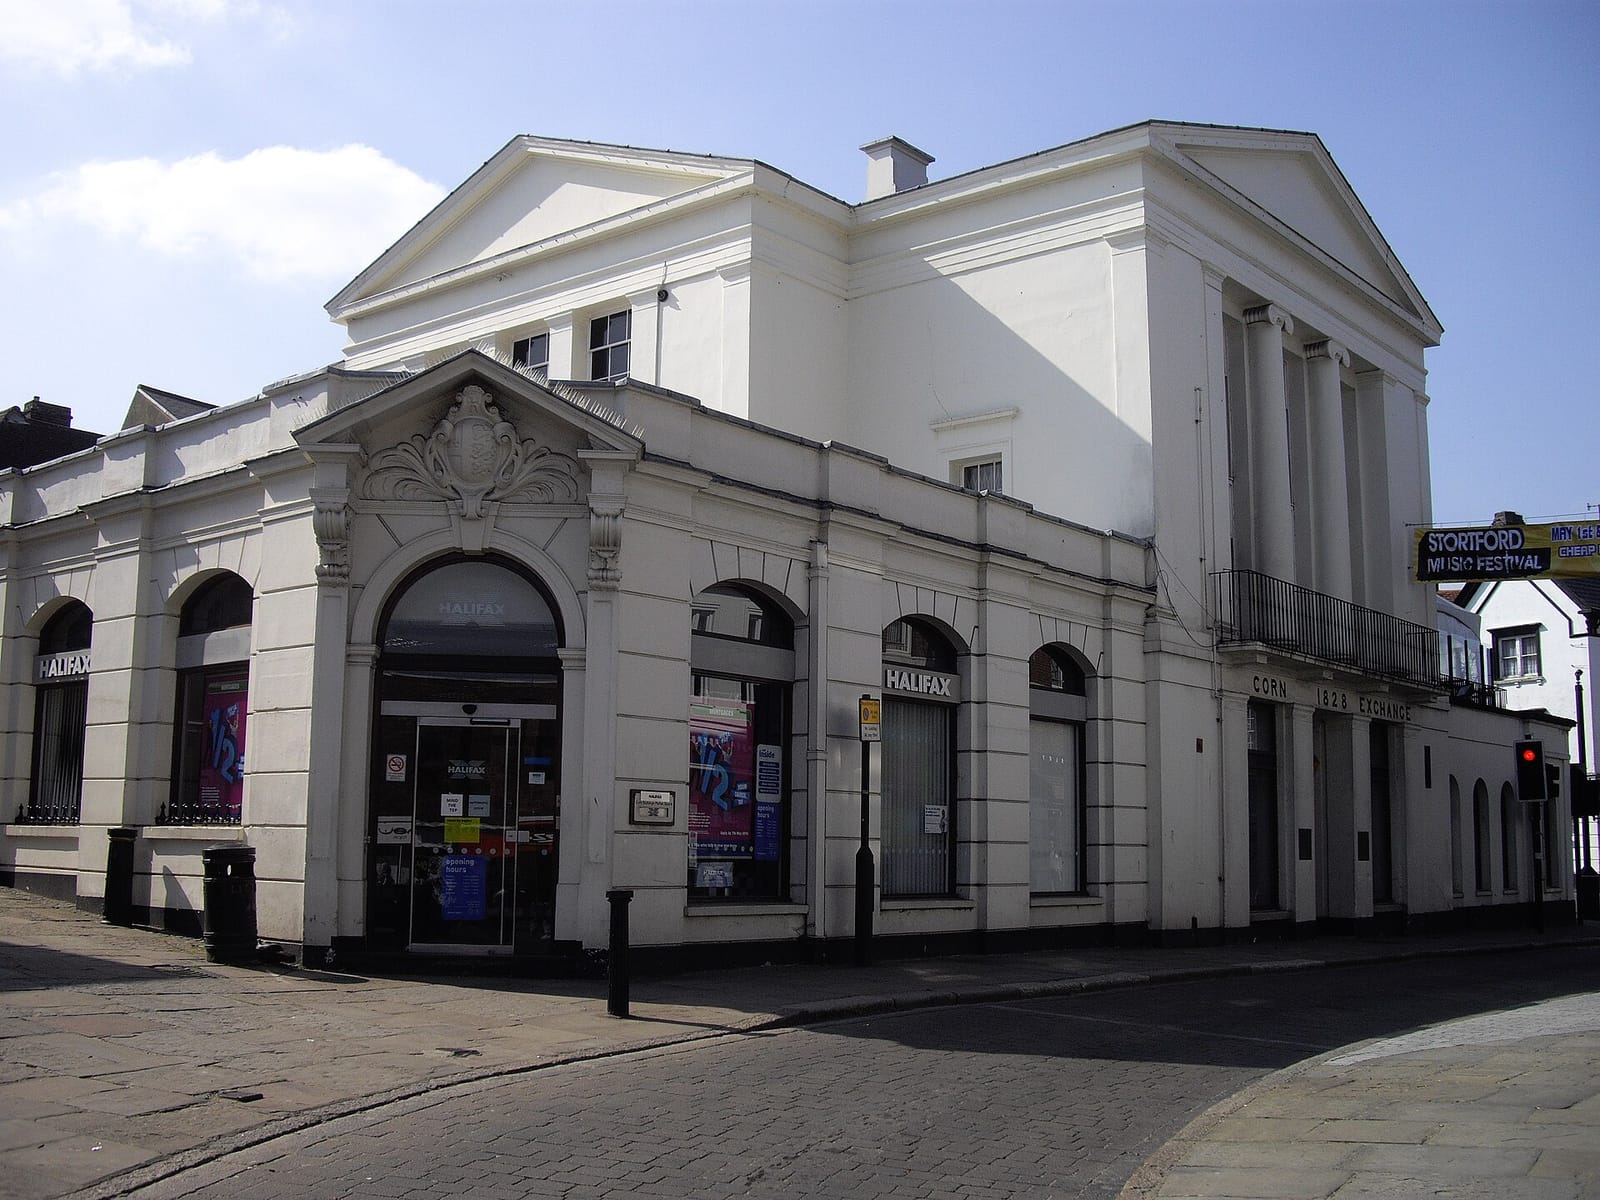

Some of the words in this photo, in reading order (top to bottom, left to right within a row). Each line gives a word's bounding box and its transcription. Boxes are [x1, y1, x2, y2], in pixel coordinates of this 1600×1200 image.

[1428, 529, 1523, 552] STORTFORD
[1552, 526, 1572, 542] MAY
[1577, 525, 1593, 539] 1st
[1558, 546, 1596, 557] CHEAP
[1427, 556, 1474, 573] MUSIC
[1476, 551, 1542, 573] FESTIVAL
[439, 602, 504, 615] HALIFAX
[39, 654, 91, 678] HALIFAX
[886, 669, 951, 697] HALIFAX
[1253, 676, 1287, 698] CORN
[1316, 687, 1348, 709] 1828
[1359, 697, 1412, 721] EXCHANGE
[447, 765, 486, 774] HALIFAX
[446, 858, 475, 866] opening
